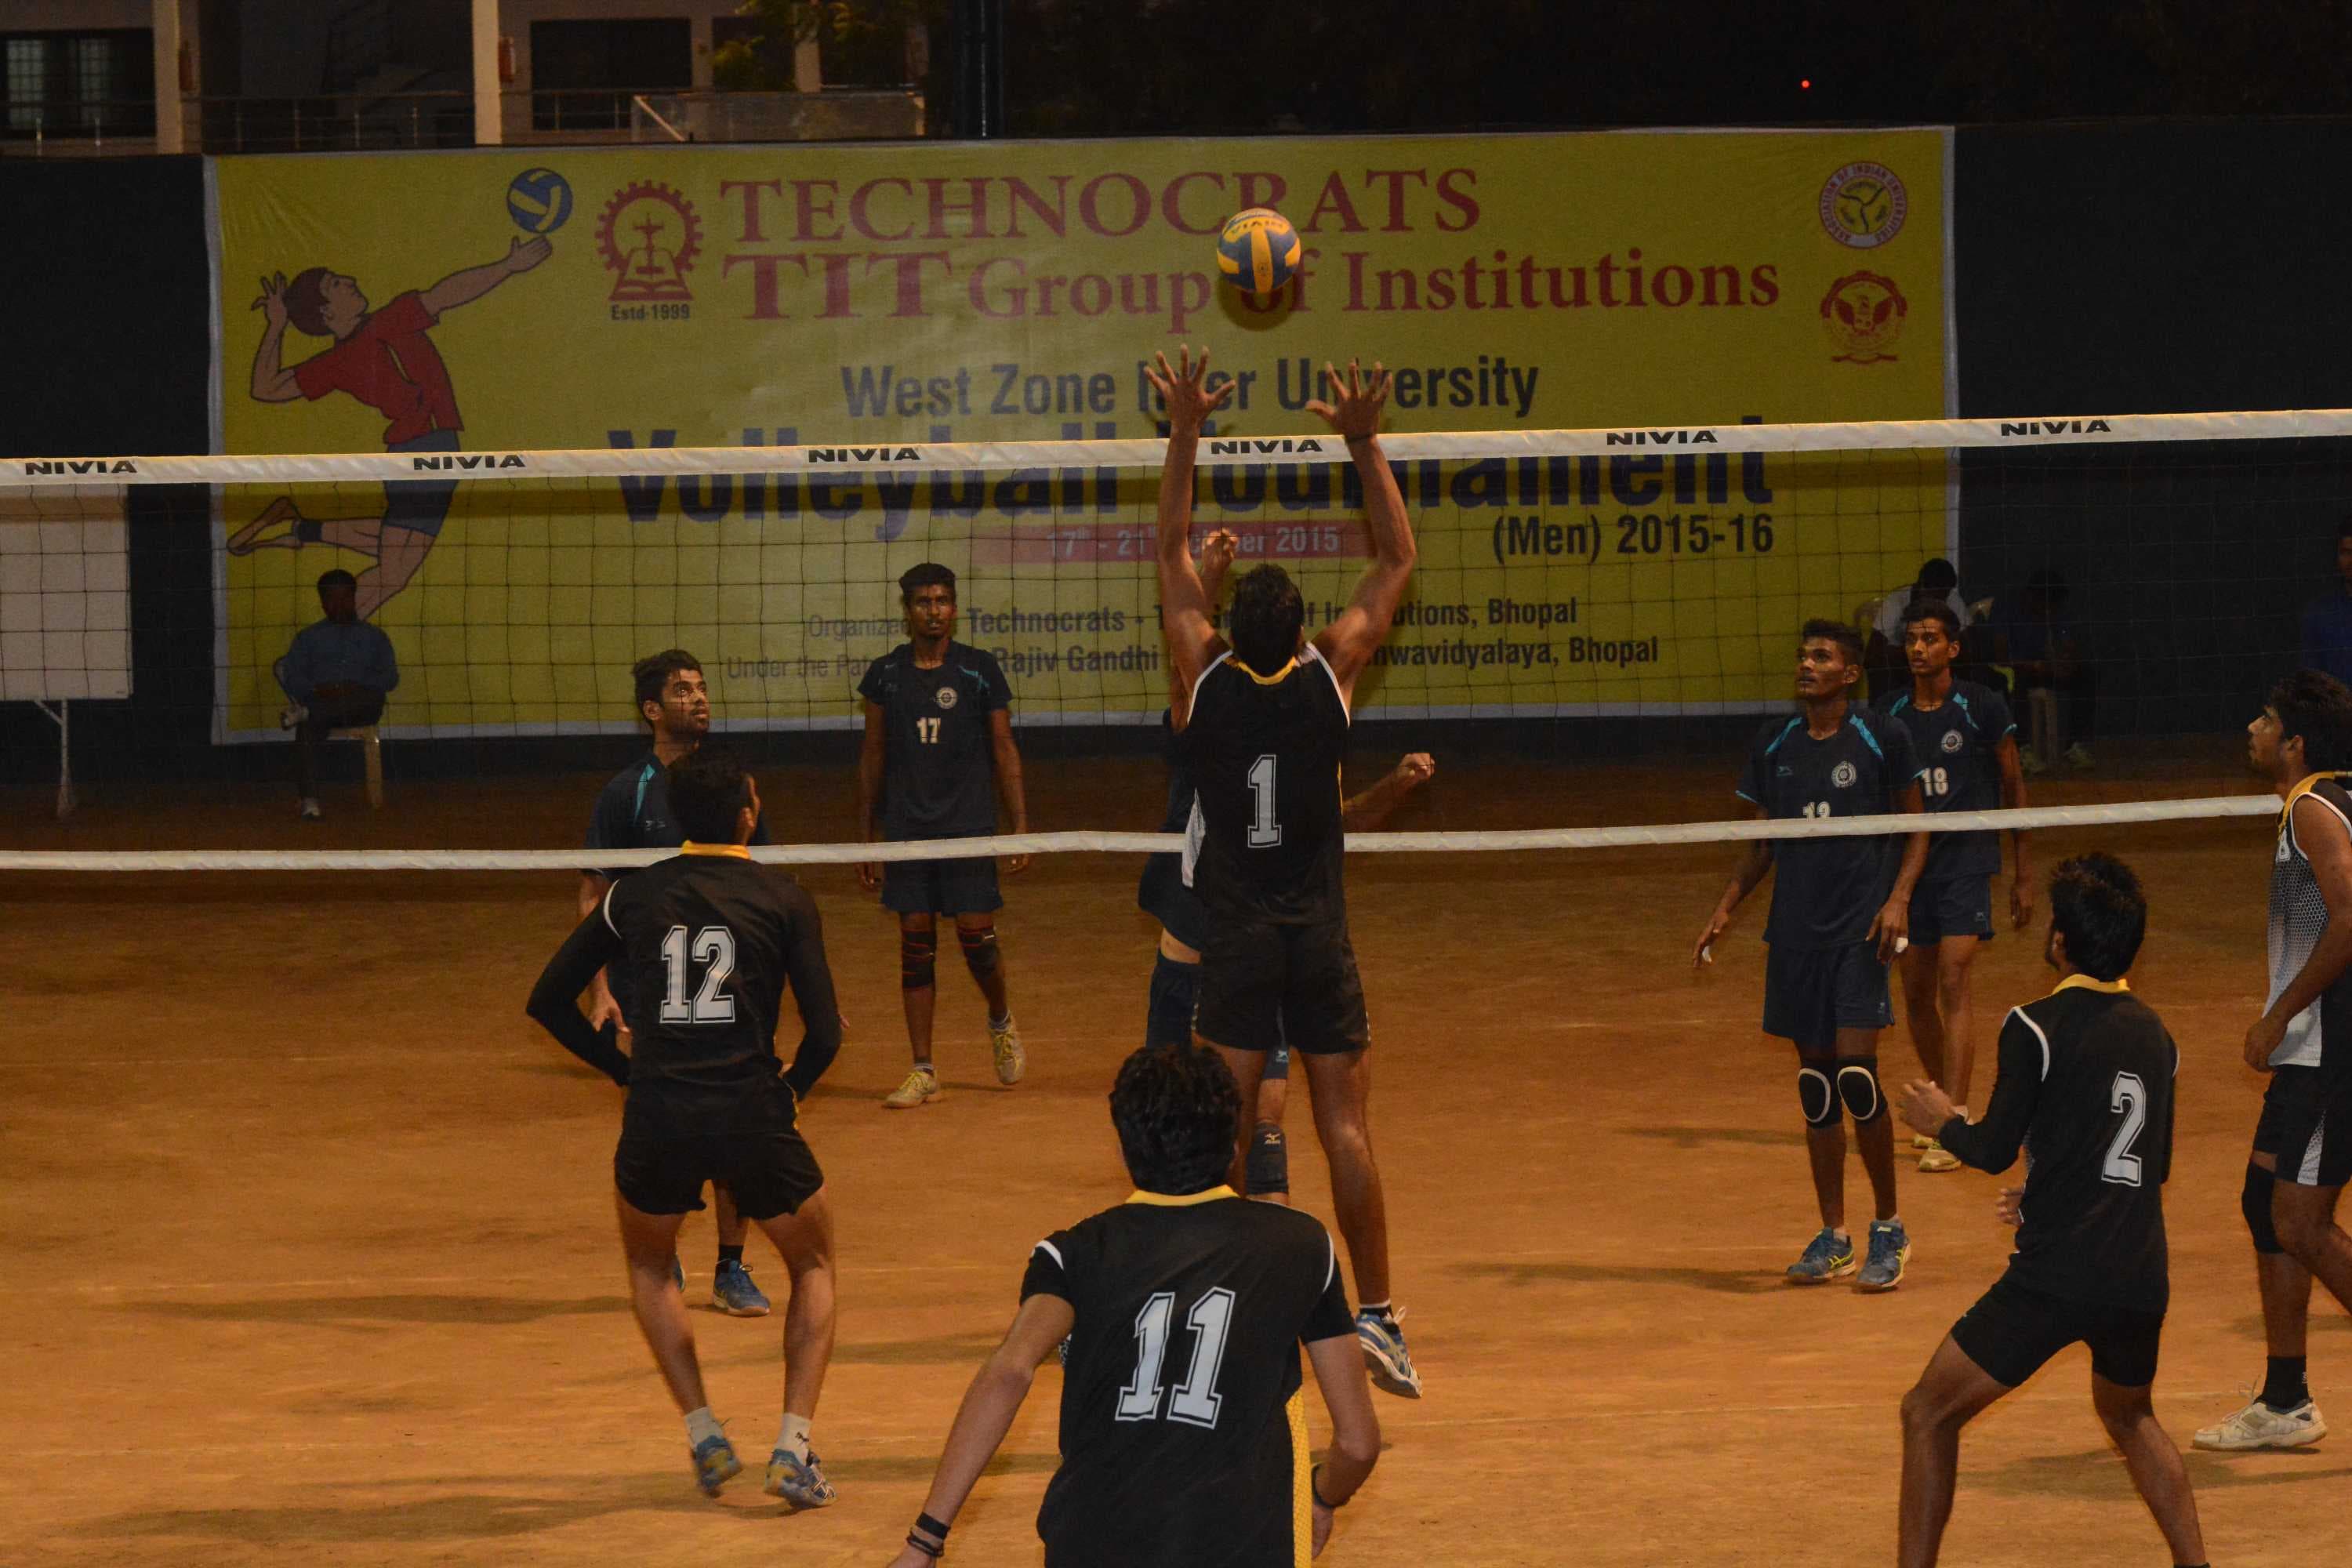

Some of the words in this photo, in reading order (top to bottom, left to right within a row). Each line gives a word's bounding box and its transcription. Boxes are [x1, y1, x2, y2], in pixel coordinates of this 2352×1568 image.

[720, 167, 1480, 242] TECHNOCRATS
[722, 250, 953, 321] TIT
[968, 257, 1211, 334] Group
[1342, 248, 1780, 313] Institutions
[841, 365, 971, 418] West
[991, 363, 1116, 415] Zone
[1138, 357, 1257, 413] Ier
[1606, 430, 1719, 446] NIVIA
[2001, 419, 2111, 437] NIVIA
[413, 454, 525, 470] NIVIA
[808, 447, 921, 463] NIVIA
[1210, 439, 1323, 455] NIVIA
[25, 459, 137, 476] NIVIA
[1276, 525, 1339, 553] 2015
[1493, 514, 1602, 564] (Men)
[1616, 514, 1774, 554] 2015-16
[967, 605, 1125, 635] Technocrats
[1488, 597, 1578, 628] Bhopal
[1067, 644, 1158, 673] Gandhi
[1569, 636, 1659, 668] Bhopal
[916, 716, 942, 745] 17
[1921, 765, 1950, 797] 18
[1247, 753, 1283, 849] 1
[659, 925, 736, 1024] 12
[2100, 1070, 2147, 1188] 2
[1114, 1286, 1236, 1429] 11
